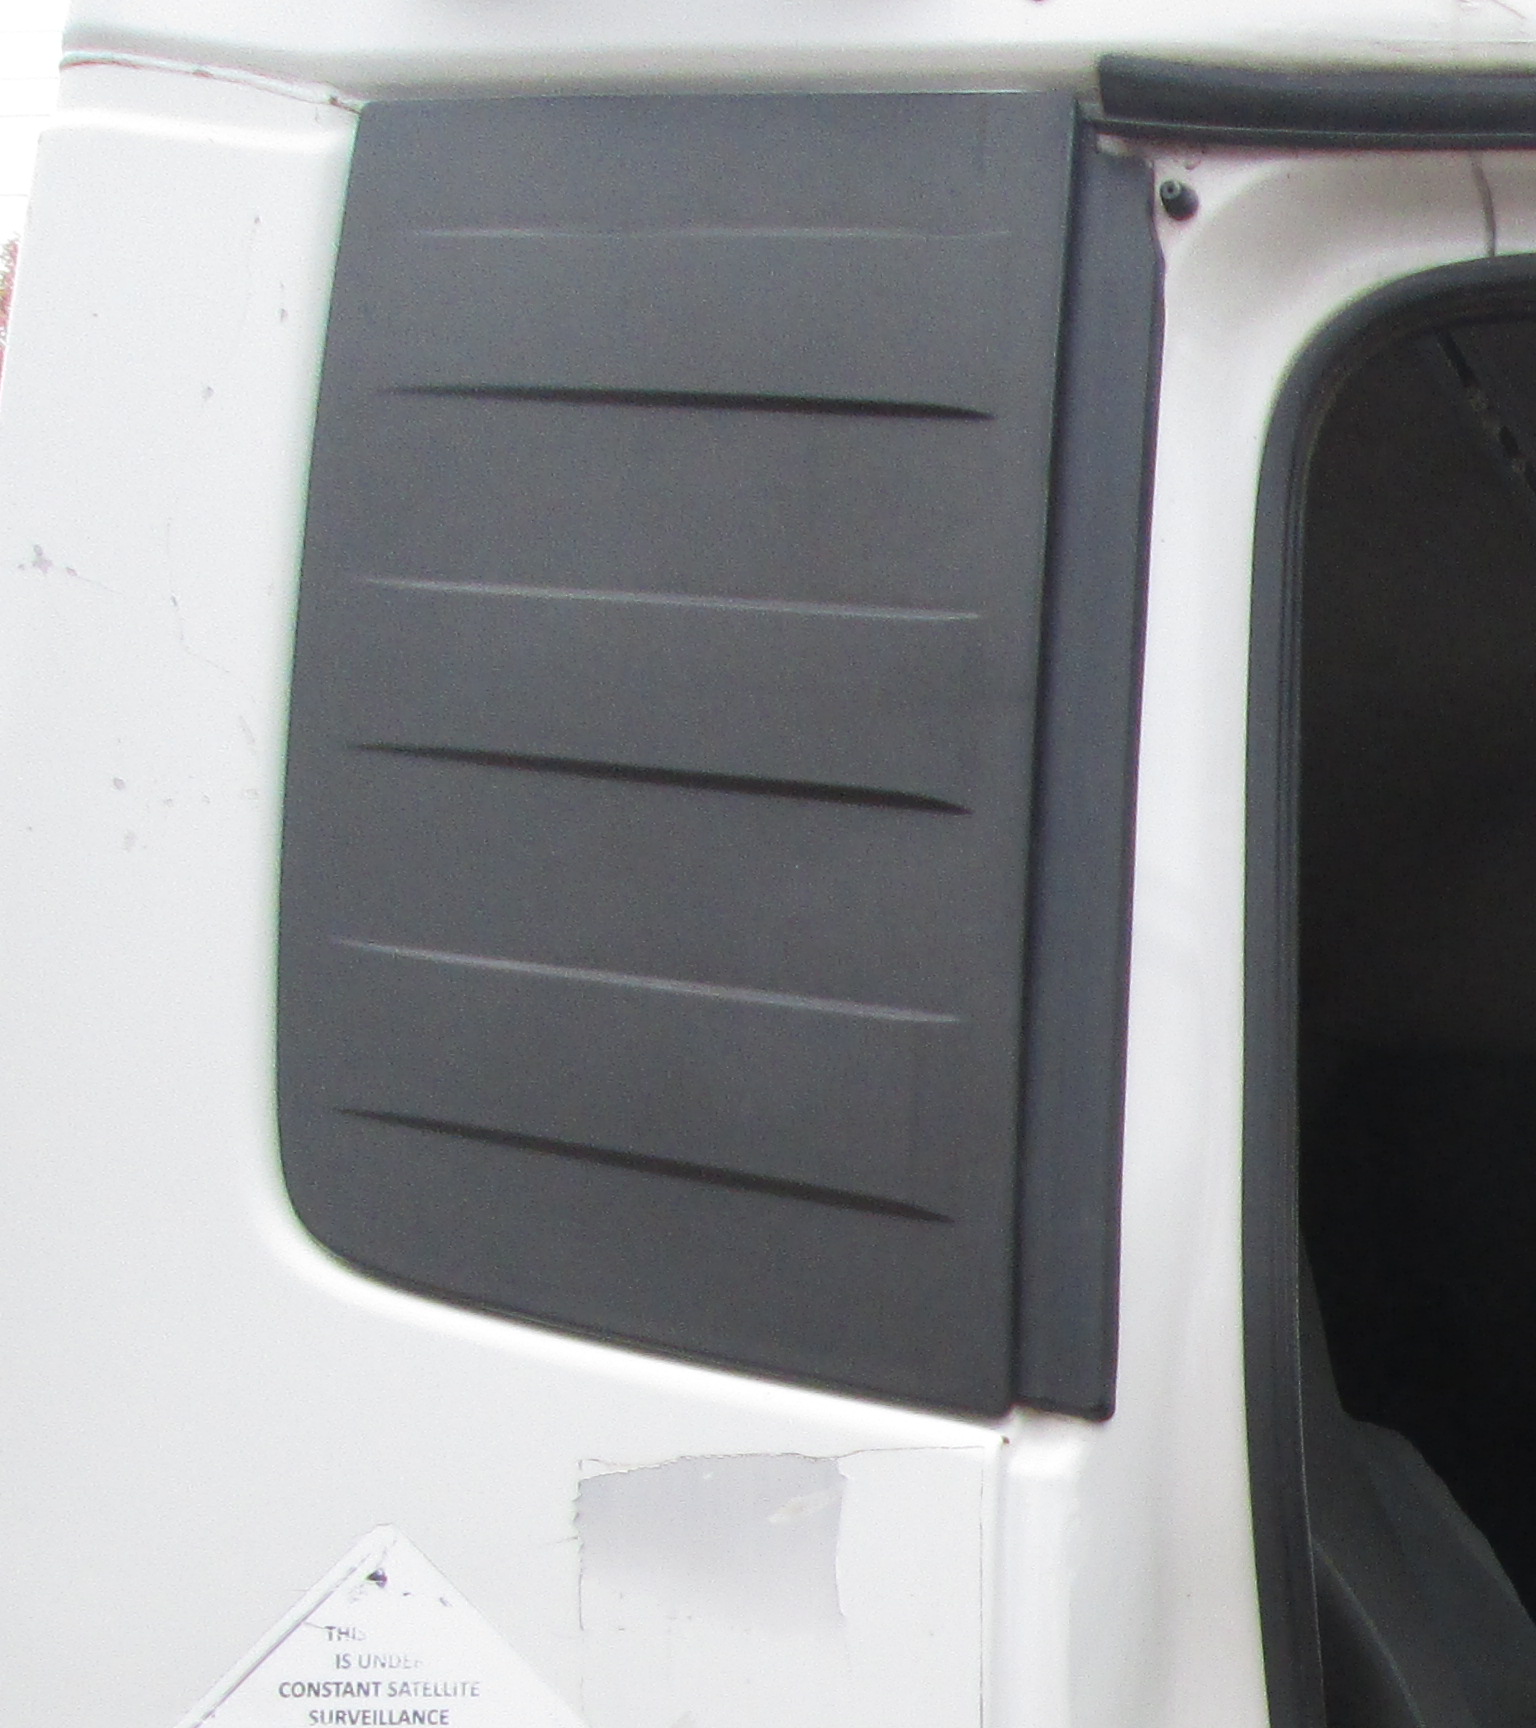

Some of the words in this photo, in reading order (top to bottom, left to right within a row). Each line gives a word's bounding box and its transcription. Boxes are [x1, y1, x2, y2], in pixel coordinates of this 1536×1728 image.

[335, 1653, 352, 1669] IS
[278, 1680, 382, 1698] CONSTANT
[387, 1680, 481, 1698] SATELLITE
[308, 1708, 450, 1726] SURVEILLANCE
